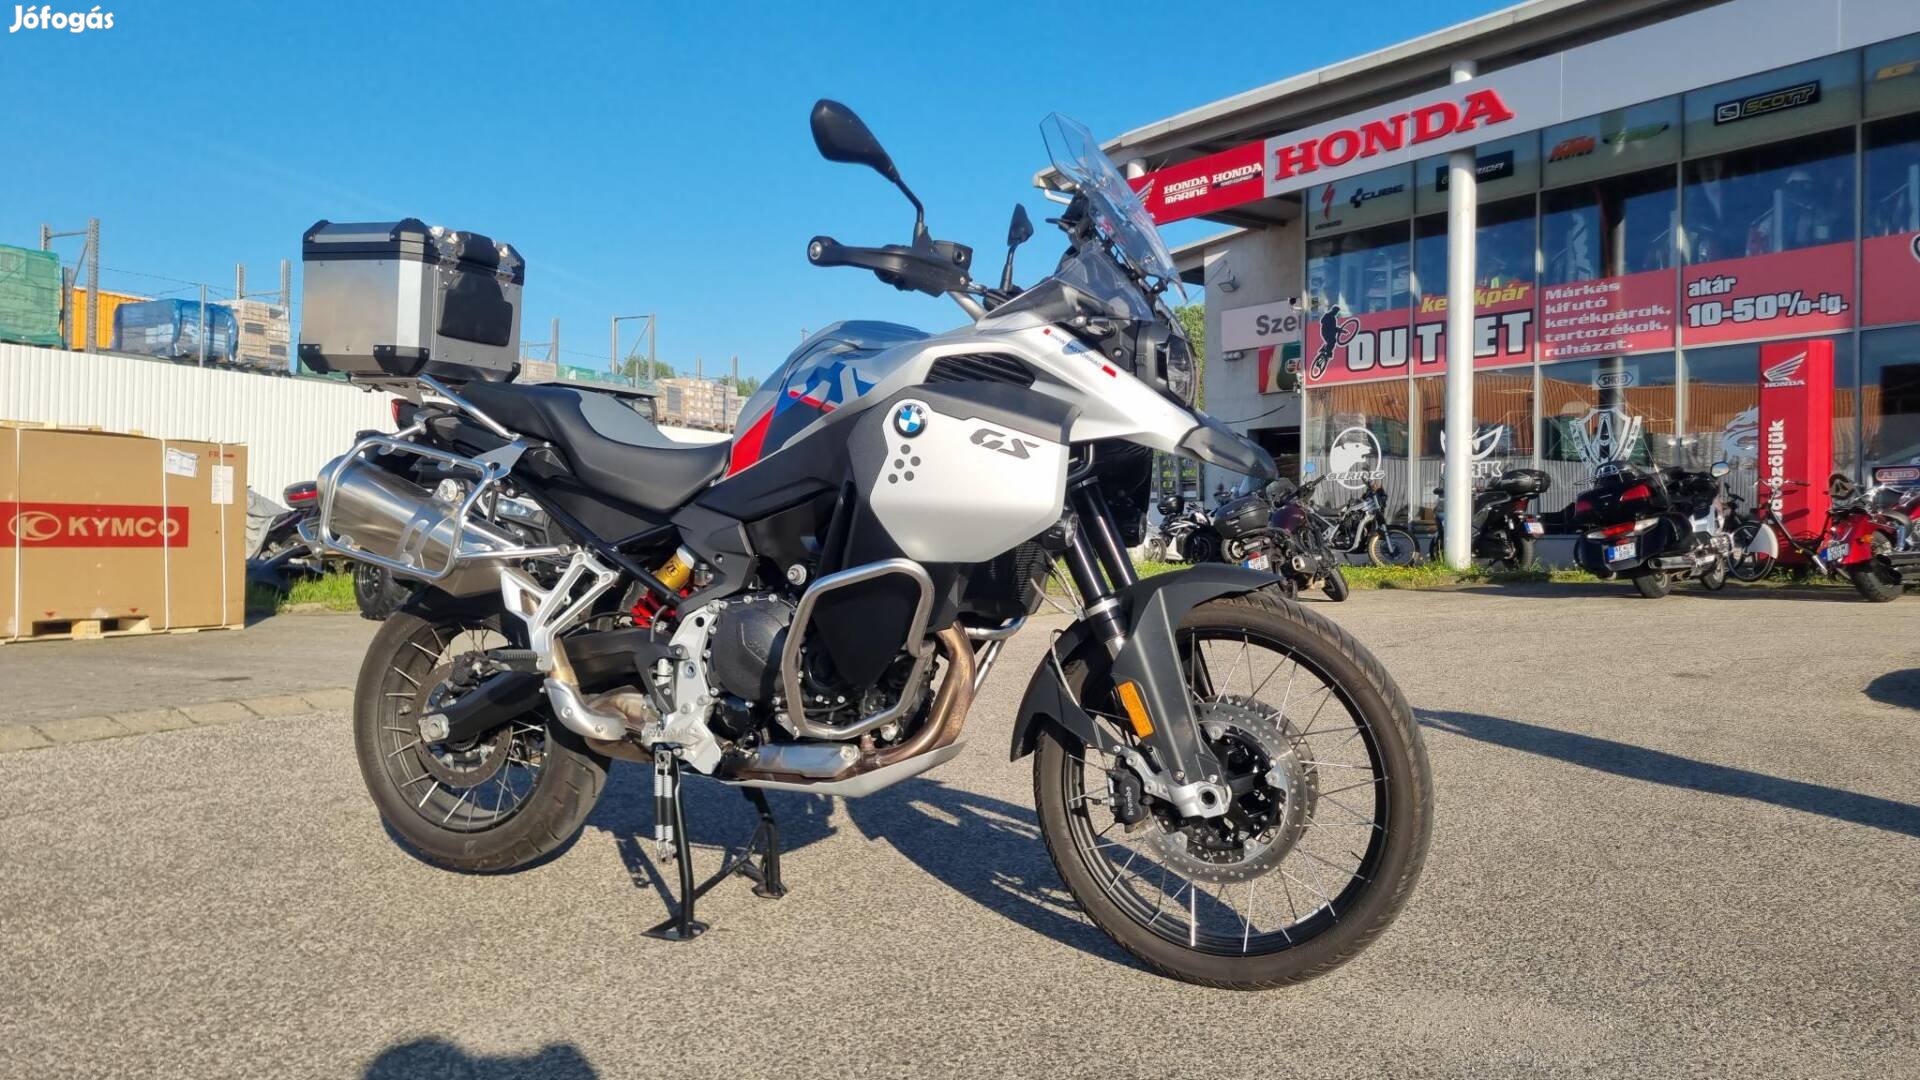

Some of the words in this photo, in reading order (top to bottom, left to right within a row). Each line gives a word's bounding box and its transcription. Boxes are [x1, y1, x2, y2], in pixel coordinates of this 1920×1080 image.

[1745, 85, 1816, 115] SCOTT
[1275, 88, 1515, 181] HONDA
[1211, 162, 1263, 184] HONDA
[1163, 176, 1209, 195] HONDA
[1164, 187, 1208, 205] MARINE
[1545, 281, 1621, 300] Márkás
[1687, 275, 1737, 297] akár
[1545, 298, 1608, 315] kifutó
[1545, 304, 1671, 329] kerékpárok,
[1687, 290, 1849, 328] 10-50%-ig.
[1347, 310, 1531, 371] OUTET
[1544, 320, 1669, 343] tartozékok,
[1544, 339, 1633, 357] ruházat.
[969, 428, 1040, 460] GS
[1326, 470, 1385, 481] BERING
[68, 516, 180, 538] KYMCO
[1125, 786, 1135, 816] brembo
